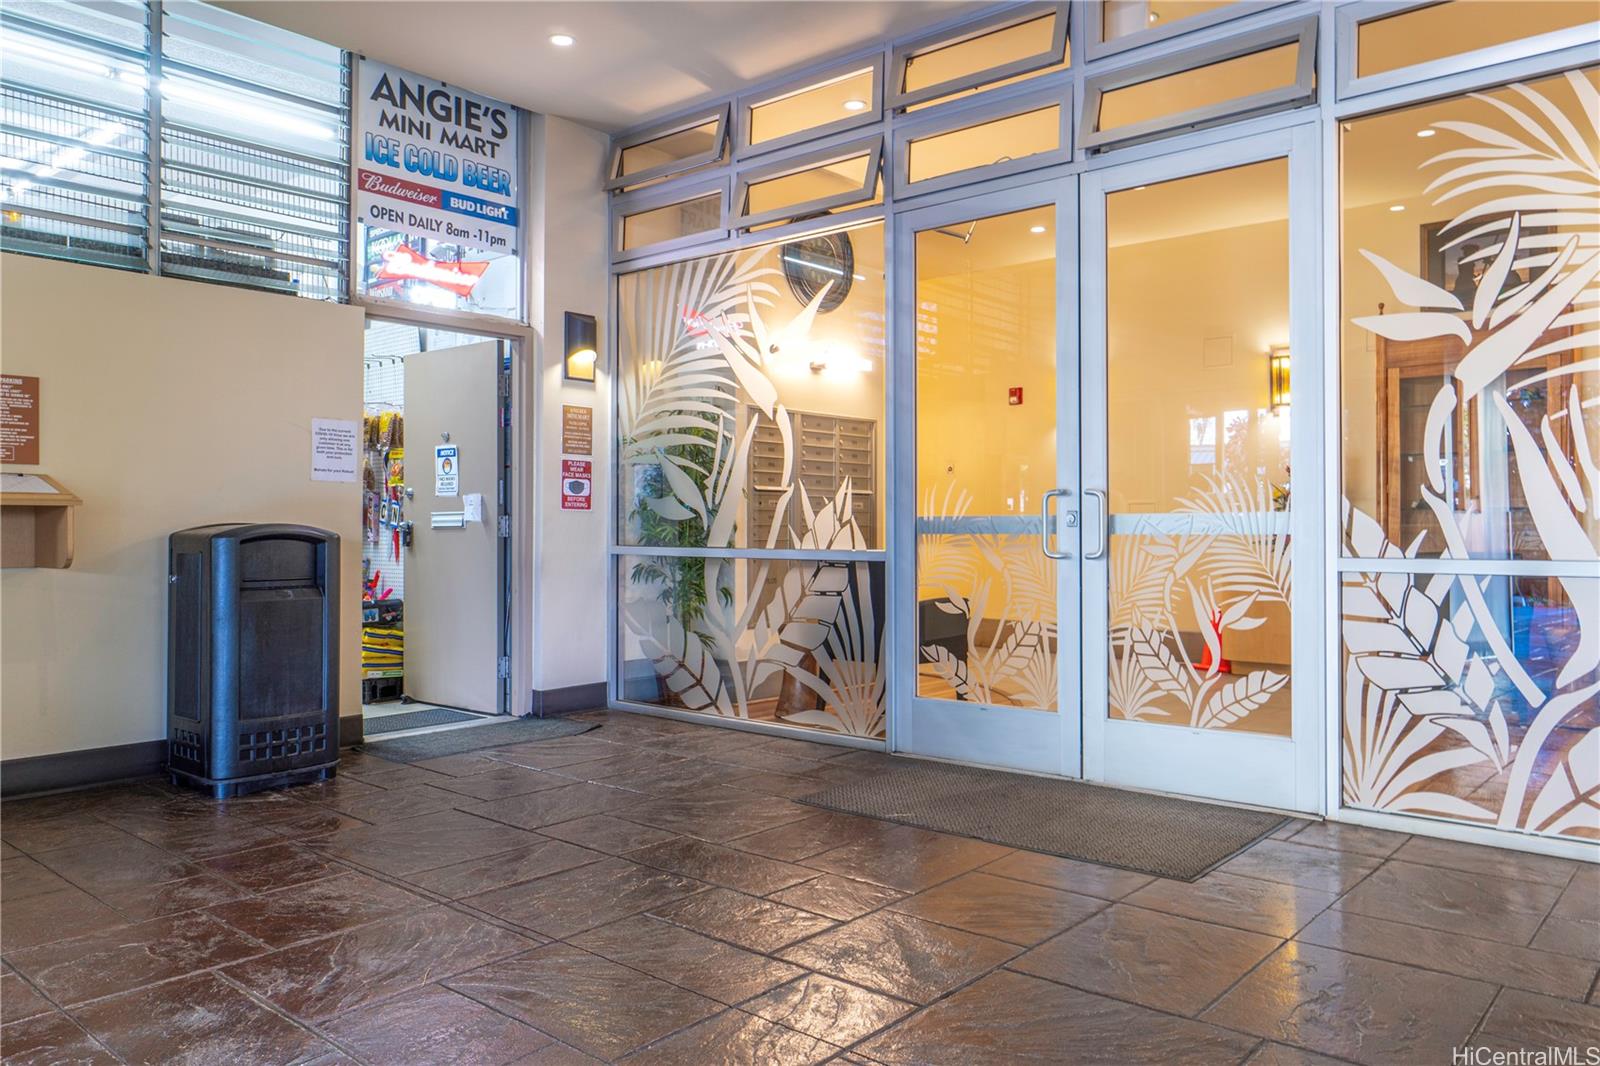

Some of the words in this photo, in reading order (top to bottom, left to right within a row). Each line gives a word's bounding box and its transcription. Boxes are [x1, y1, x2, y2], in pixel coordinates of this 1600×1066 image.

[370, 72, 509, 140] ANGIE'S
[379, 109, 431, 140] MINI
[440, 127, 500, 159] MART
[365, 131, 400, 168] ICE
[404, 143, 458, 183] COLD
[462, 156, 511, 197] BEER
[361, 172, 440, 204] Budweiser
[450, 197, 474, 213] BUD
[475, 200, 510, 220] LIGHT
[370, 204, 404, 225] OPEN
[409, 214, 443, 234] DAILY
[446, 222, 469, 239] 8am
